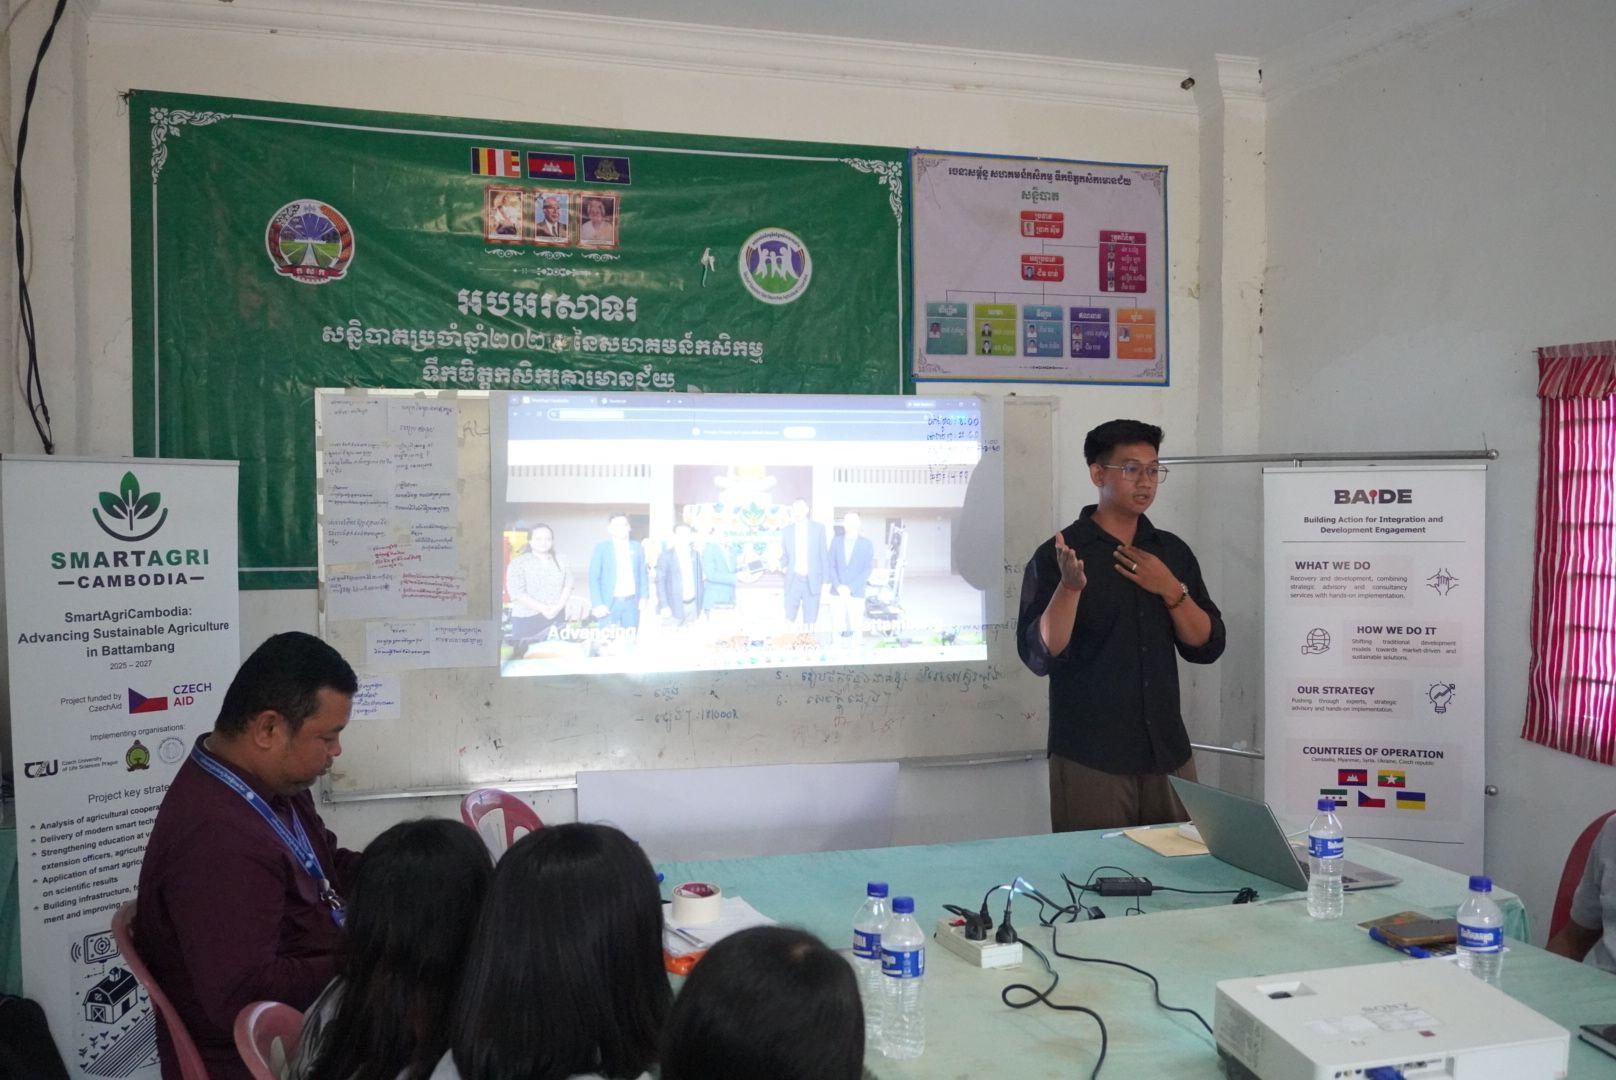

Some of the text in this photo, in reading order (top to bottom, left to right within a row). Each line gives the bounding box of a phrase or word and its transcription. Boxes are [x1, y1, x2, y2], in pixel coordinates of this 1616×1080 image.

[458, 288, 638, 322] អបអរសាទរ
[1304, 516, 1336, 524] Building
[1338, 516, 1364, 524] Action
[1379, 516, 1426, 524] Integration
[1320, 526, 1426, 534] Development Engagement
[51, 548, 209, 570] SMARTAGRI
[1295, 561, 1370, 570] WHAT WE DO
[78, 572, 188, 588] CAMBODIA
[1290, 576, 1316, 584] Recovery
[64, 606, 192, 623] SmartAgriCambodia:
[18, 620, 230, 645] Advancing Sustainable Agriculture
[1357, 626, 1436, 635] HOW WE DO IT
[86, 642, 174, 658] in Battambang
[110, 662, 127, 670] 2025
[135, 660, 152, 668] 2027
[173, 682, 212, 696] CZECH
[1298, 686, 1375, 695] OUR STRATEGY
[60, 692, 122, 707] Project funded by
[88, 702, 122, 713] CzechAid
[174, 696, 194, 707] AID
[90, 730, 136, 742] Implementing
[1302, 746, 1444, 759] COUNTRIES OF OPERATION
[24, 760, 58, 778] CZU
[88, 791, 122, 804] Project
[124, 788, 140, 798] key
[40, 820, 74, 830] Analysis
[76, 816, 84, 824] of
[86, 809, 128, 822] agricultural
[40, 833, 73, 844] Delivery
[85, 826, 114, 836] modern
[116, 821, 136, 830] smart
[41, 842, 96, 856] Strengthening
[98, 834, 134, 846] education
[136, 832, 144, 840] at
[42, 858, 80, 870] extension
[42, 870, 87, 884] Application
[98, 863, 120, 872] smart
[42, 876, 118, 898] on scientific results
[43, 898, 76, 910] Building
[78, 886, 132, 903] infrastructure,
[44, 902, 120, 924] ment and improving
